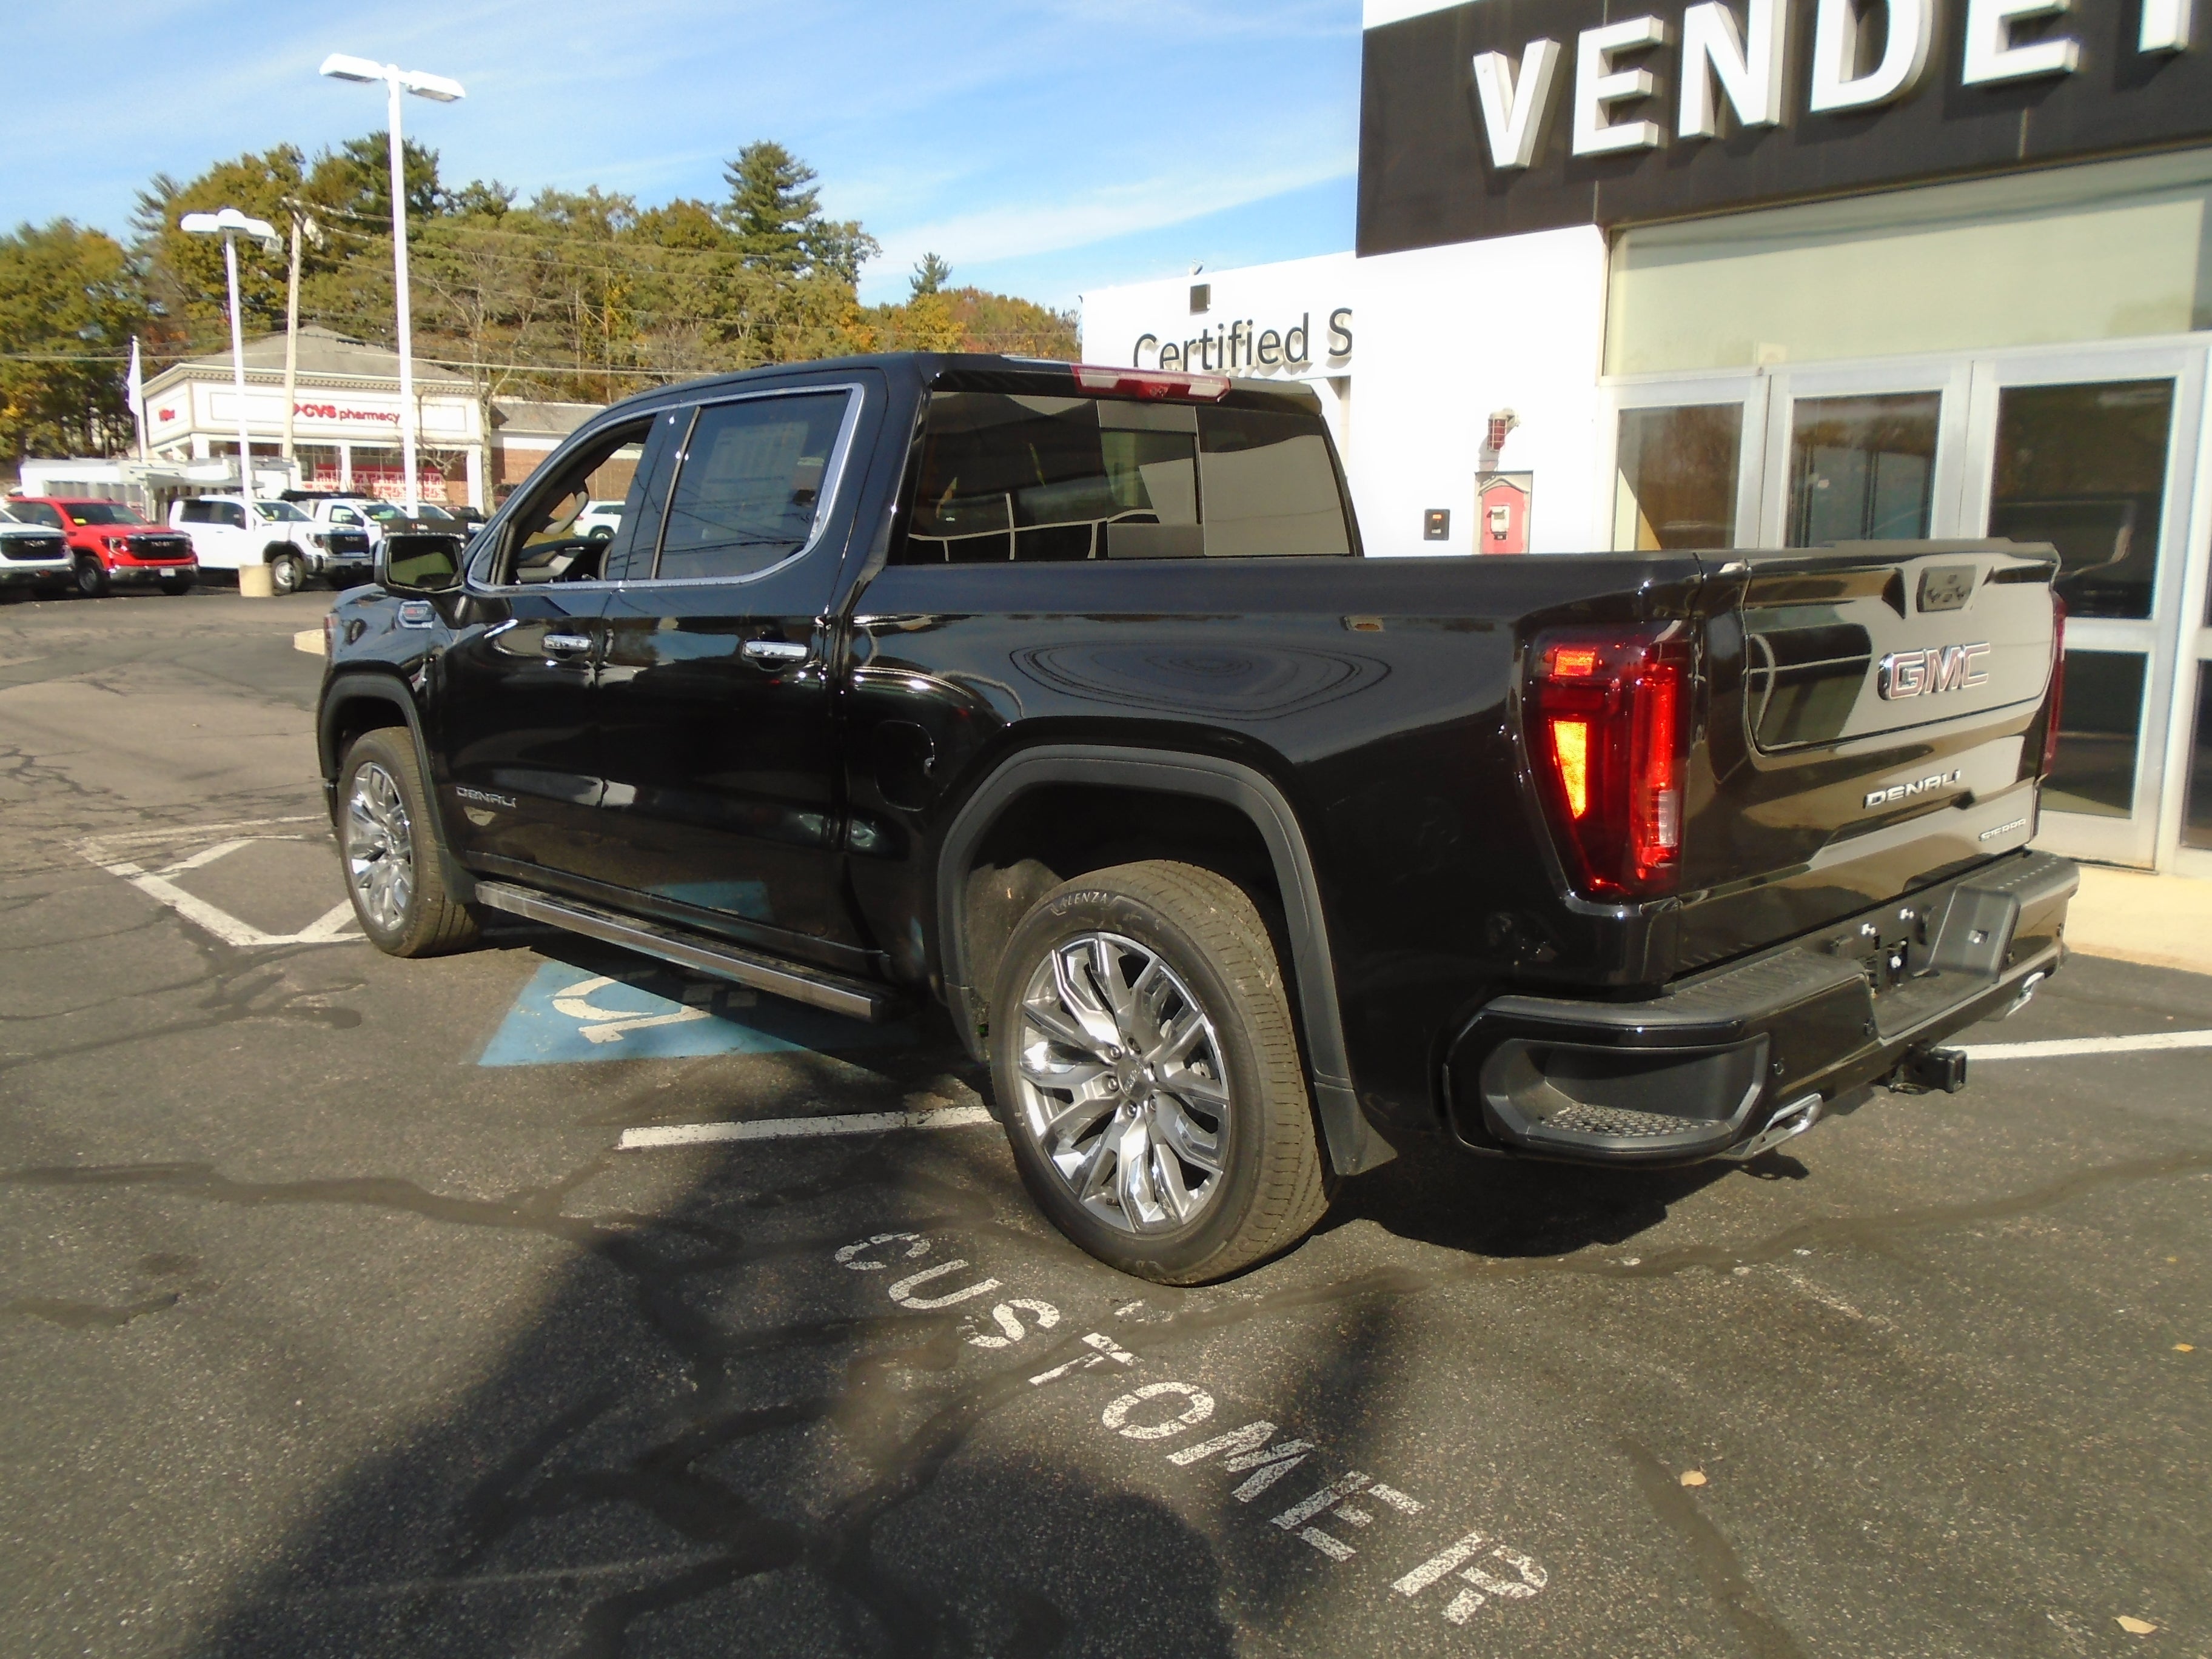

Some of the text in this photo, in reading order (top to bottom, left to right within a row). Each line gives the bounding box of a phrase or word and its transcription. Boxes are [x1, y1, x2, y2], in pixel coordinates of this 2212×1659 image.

[1133, 311, 1310, 371] Certified
[301, 403, 400, 426] CVS pharmacy
[1877, 642, 1991, 700] GMC
[455, 786, 517, 808] DENALI
[1863, 768, 1962, 809] DENALI
[1979, 819, 2026, 841] SIERRA
[1059, 891, 1107, 908] ALENZA
[834, 1230, 1550, 1625] CUSTOMER
